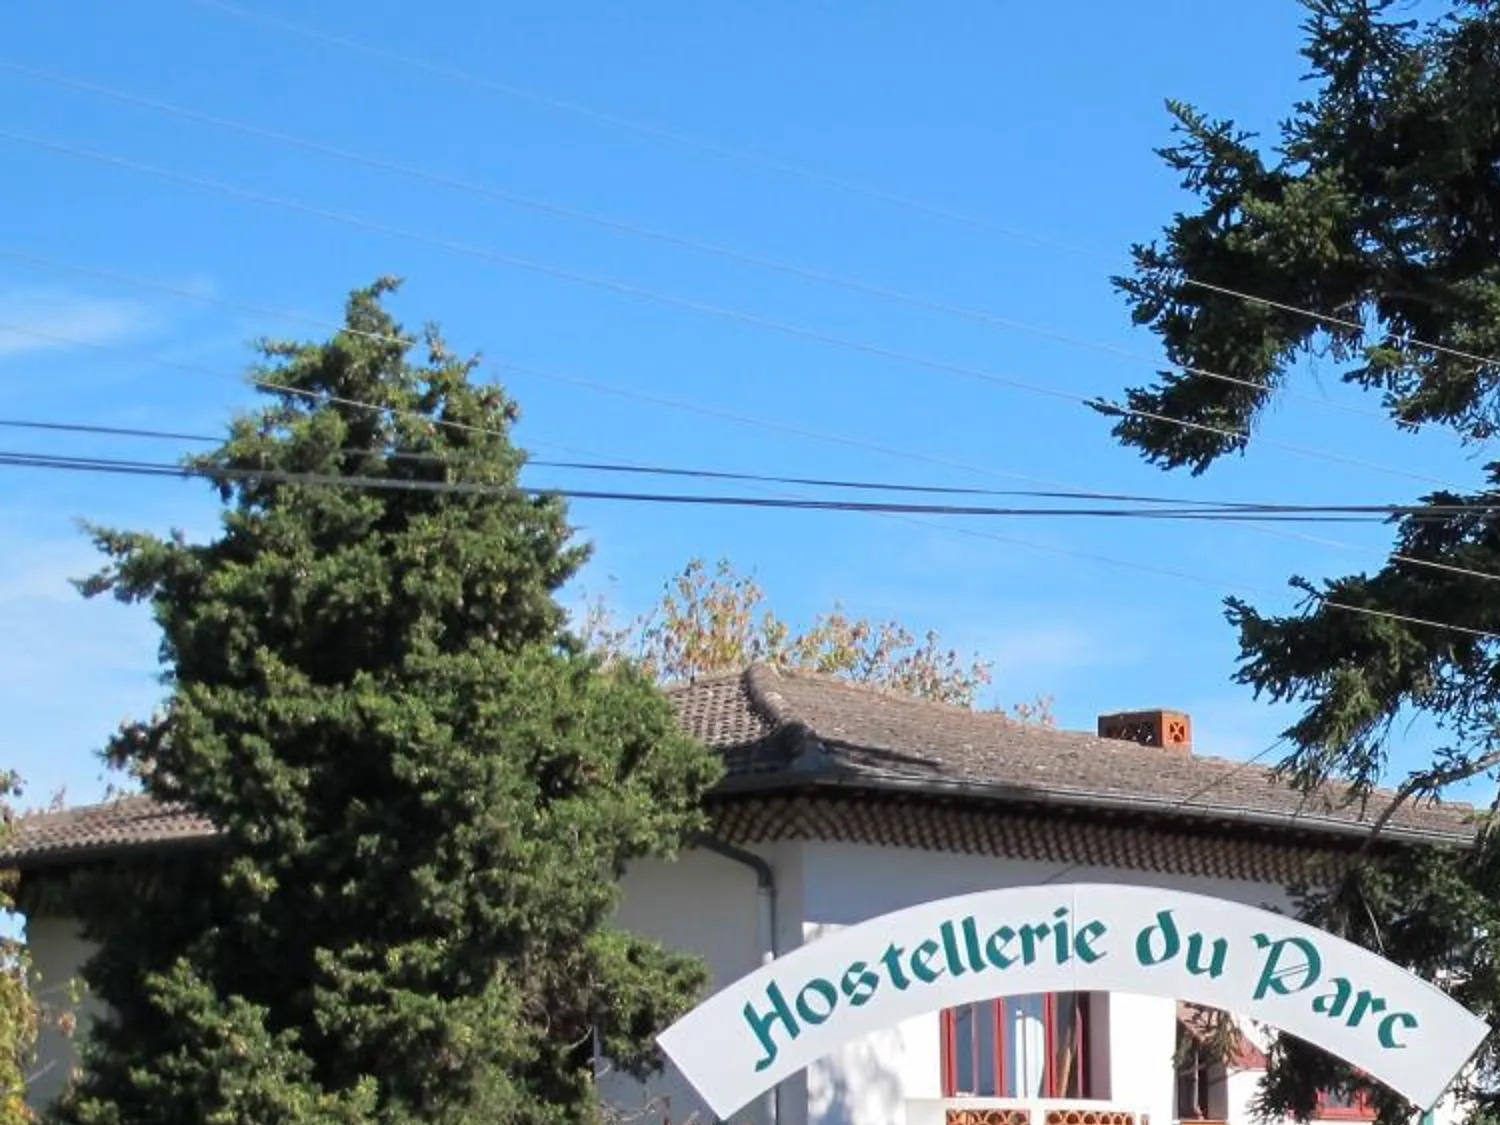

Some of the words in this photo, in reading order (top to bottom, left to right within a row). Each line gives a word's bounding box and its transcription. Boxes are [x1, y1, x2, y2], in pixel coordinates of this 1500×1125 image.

[744, 907, 1107, 1071] Hostellerie
[1136, 910, 1228, 978] du
[1252, 932, 1418, 1049] Parc
